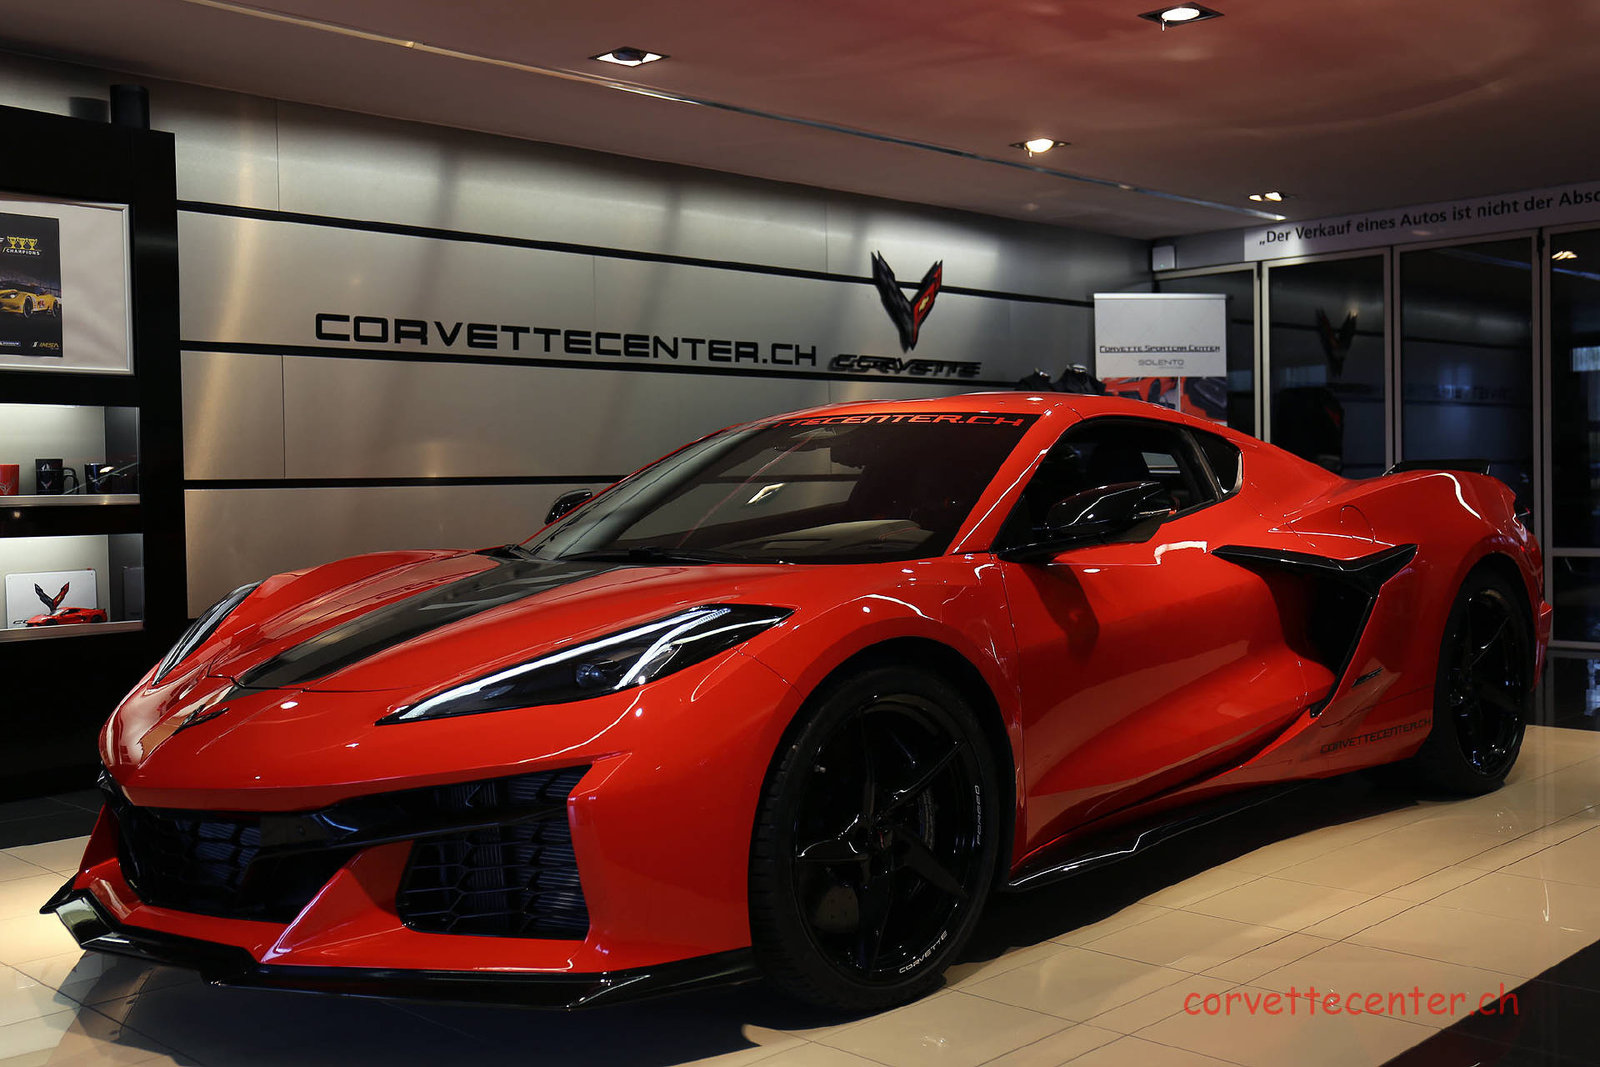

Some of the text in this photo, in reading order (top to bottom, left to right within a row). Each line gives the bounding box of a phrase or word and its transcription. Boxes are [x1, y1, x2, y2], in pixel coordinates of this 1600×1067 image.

[1296, 220, 1351, 240] Verkauf
[1356, 217, 1396, 232] eines
[1401, 210, 1447, 227] Autos
[1452, 204, 1471, 221] ist
[1477, 200, 1519, 218] nicht
[1524, 195, 1553, 212] der
[6, 248, 40, 256] CHAMPIONS
[315, 313, 817, 367] CORVETTECENTER.CH
[832, 354, 982, 377] CORVETTE
[899, 930, 948, 973] CORVETTE
